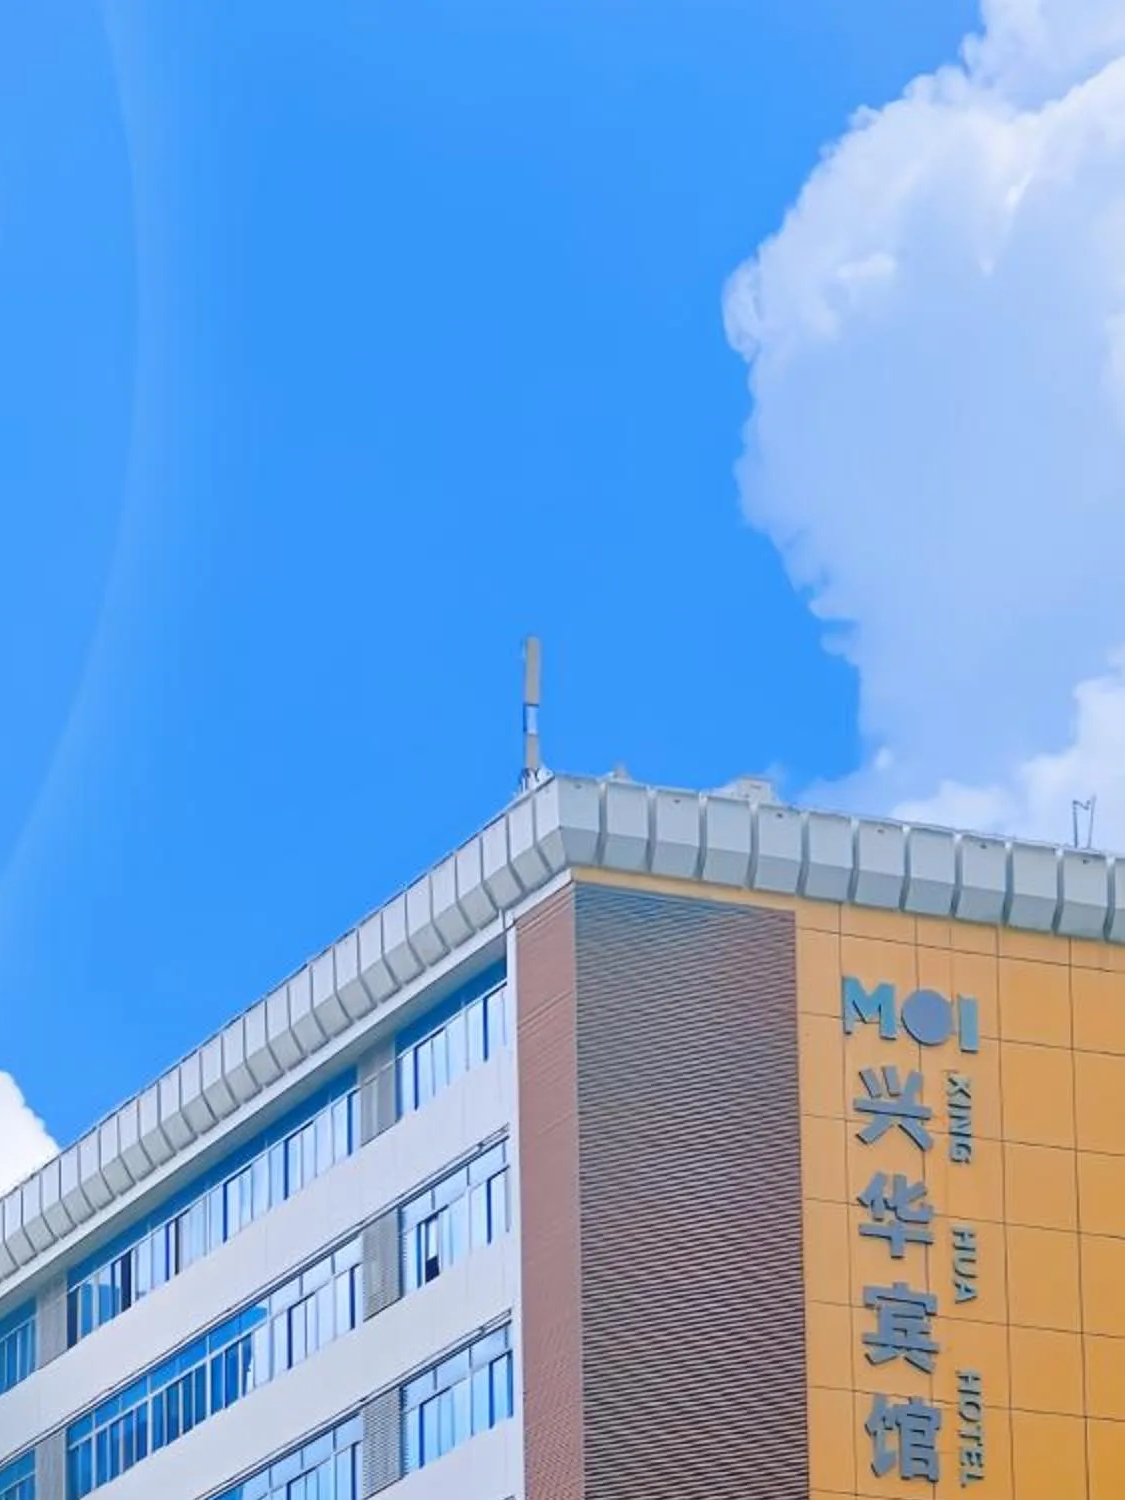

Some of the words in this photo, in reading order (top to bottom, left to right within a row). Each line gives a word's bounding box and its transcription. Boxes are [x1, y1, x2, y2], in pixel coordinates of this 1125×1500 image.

[841, 975, 979, 1053] MOI
[853, 1064, 941, 1484] 兴华宾馆
[952, 1222, 978, 1305] HUA
[956, 1367, 985, 1487] HOTEL
